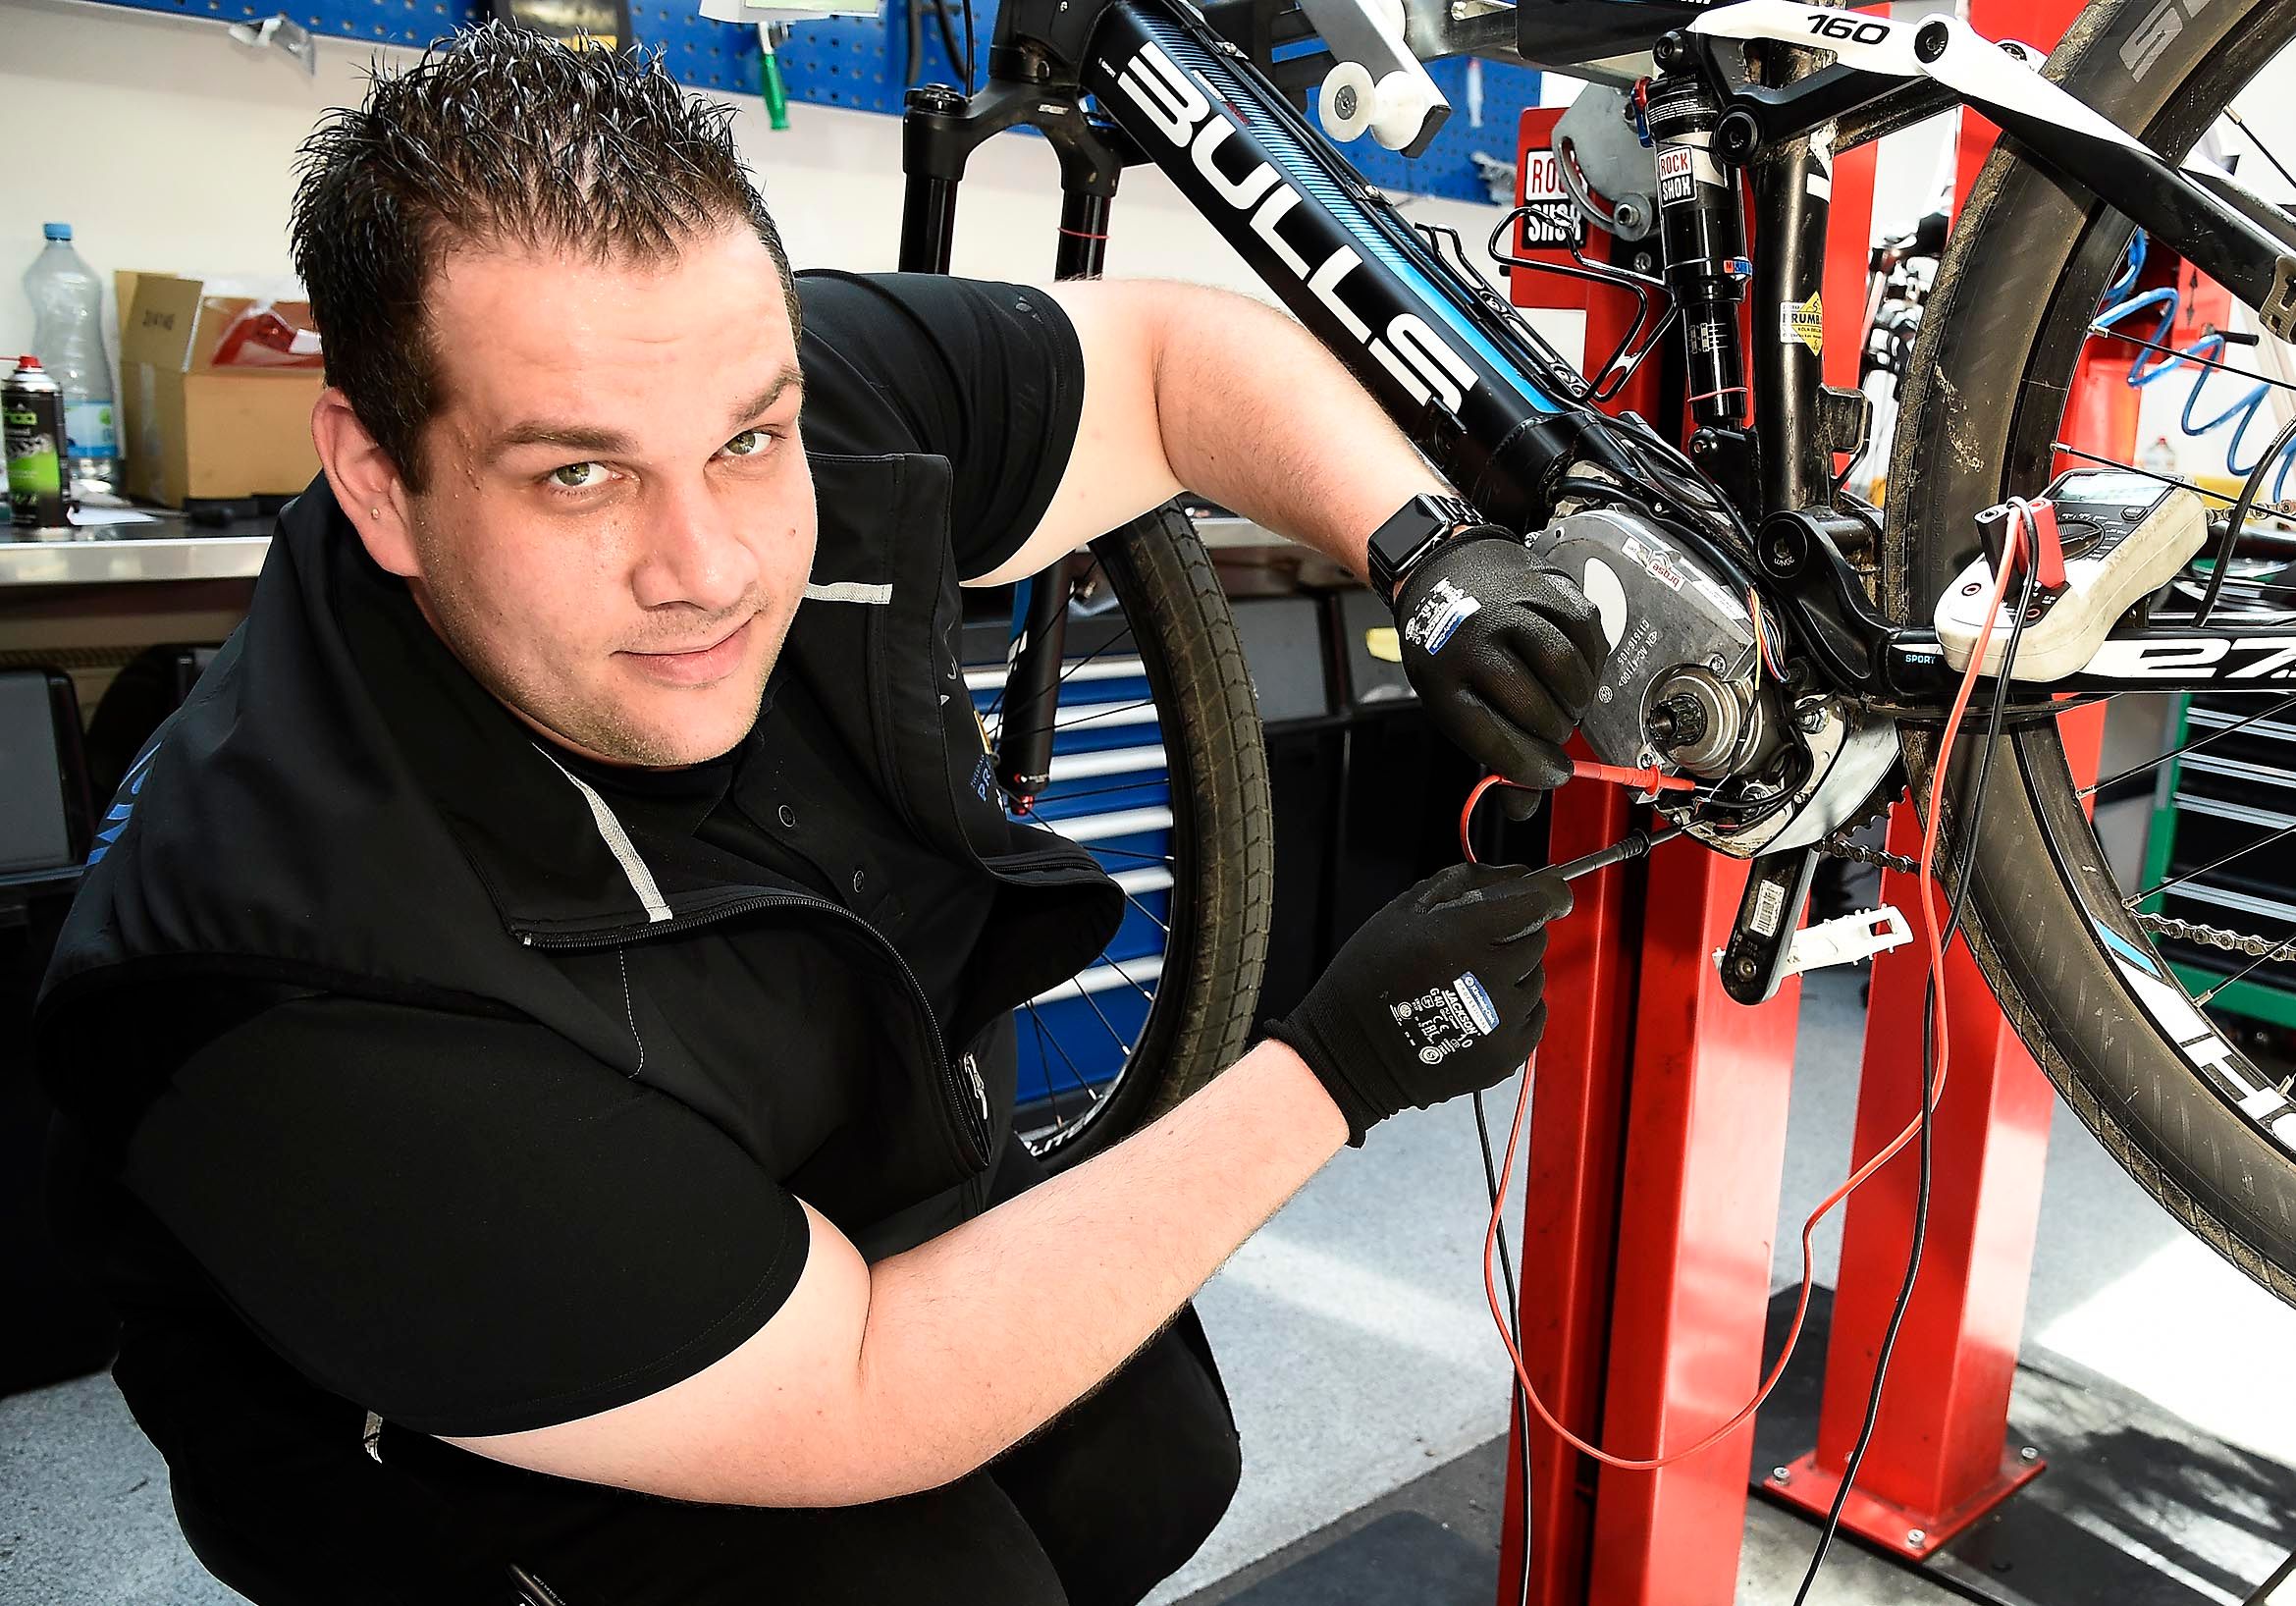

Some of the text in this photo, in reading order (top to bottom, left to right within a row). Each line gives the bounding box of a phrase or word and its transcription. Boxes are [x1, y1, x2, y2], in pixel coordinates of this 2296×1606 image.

[1807, 14, 1891, 45] 160
[1660, 152, 1688, 177] ROCK
[1662, 175, 1691, 201] SHOX
[1117, 40, 1479, 413] BULLS
[1652, 562, 1683, 588] brose
[1904, 654, 1936, 665] SPORT
[1445, 990, 1478, 1036] JACKSON
